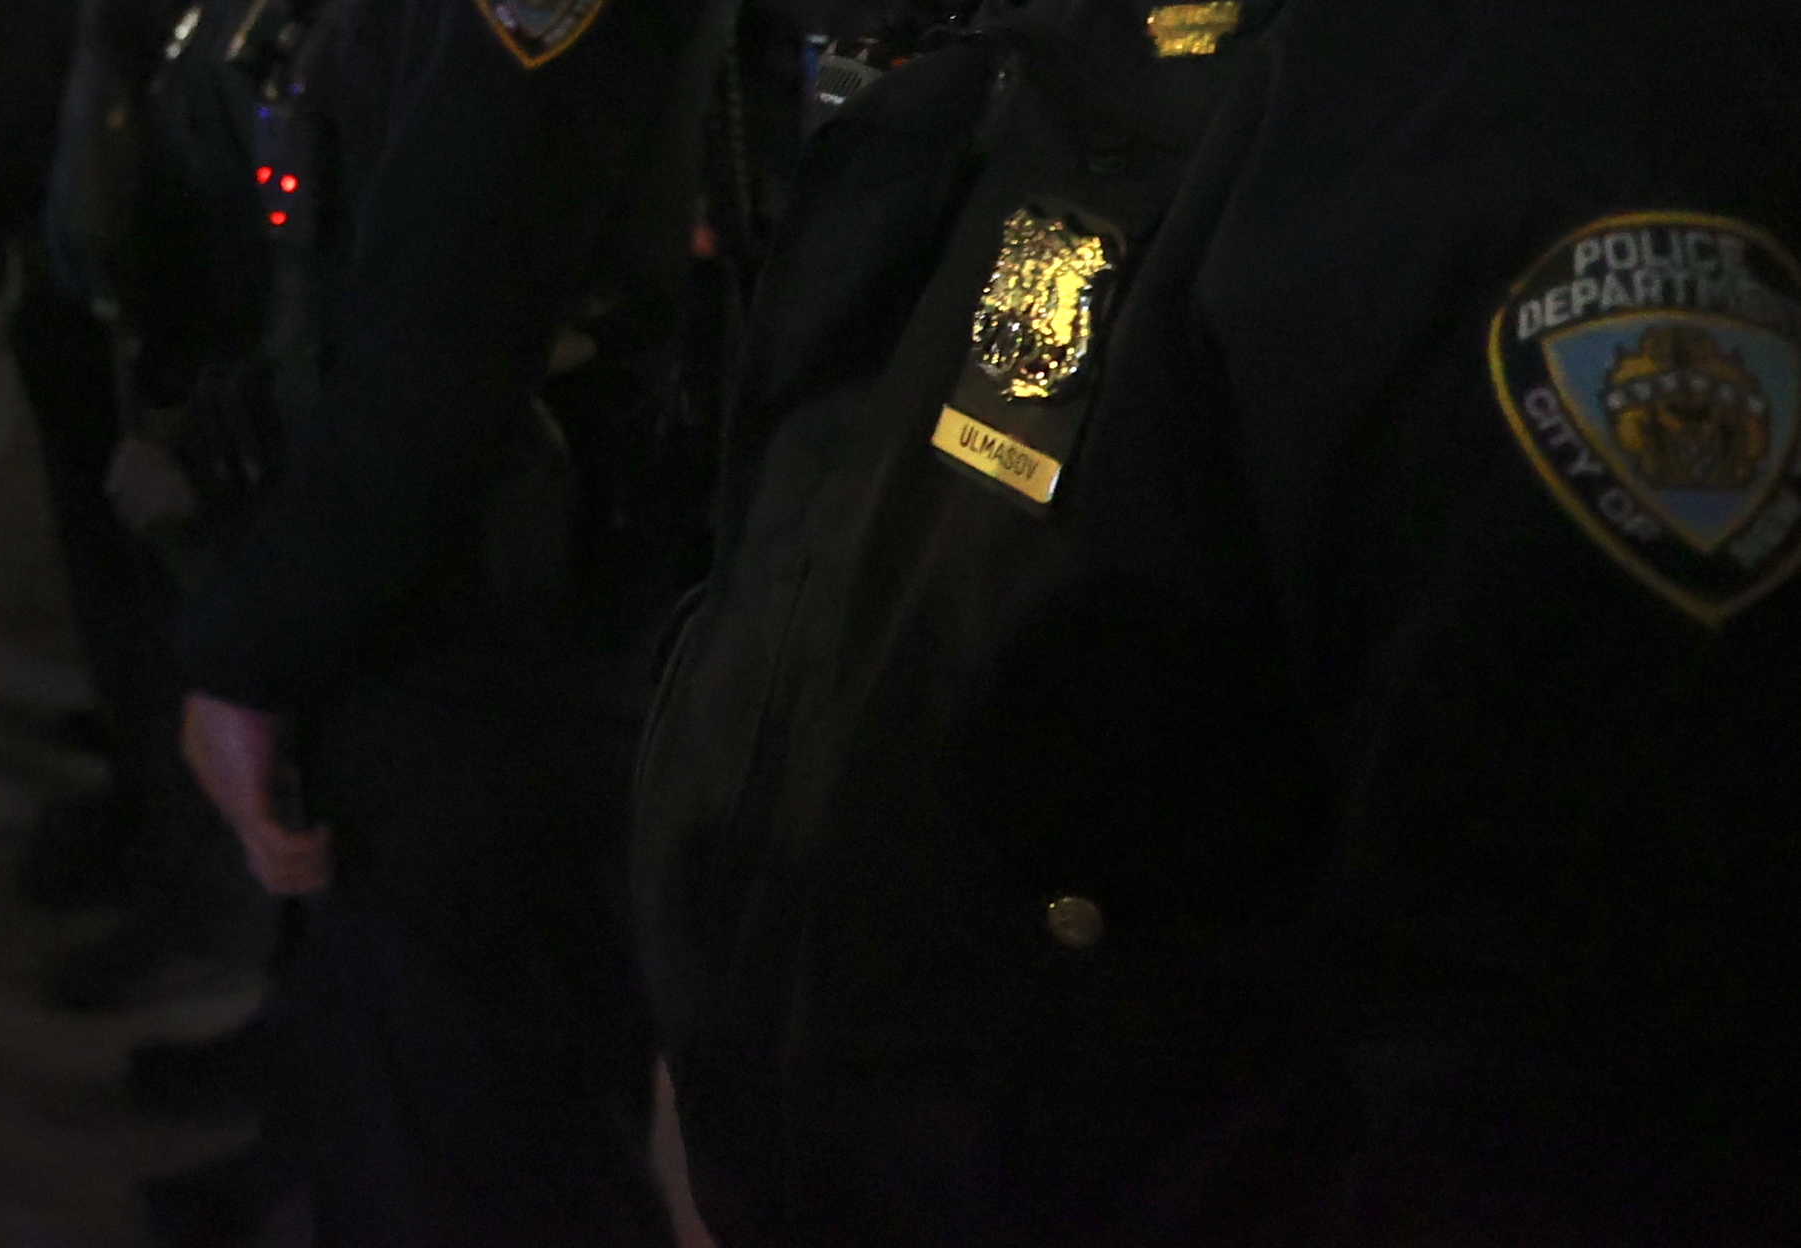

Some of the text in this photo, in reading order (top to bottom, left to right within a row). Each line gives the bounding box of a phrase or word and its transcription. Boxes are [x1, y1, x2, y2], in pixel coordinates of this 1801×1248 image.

[1573, 226, 1744, 278] POLICE
[1524, 386, 1663, 543] CITY OF
